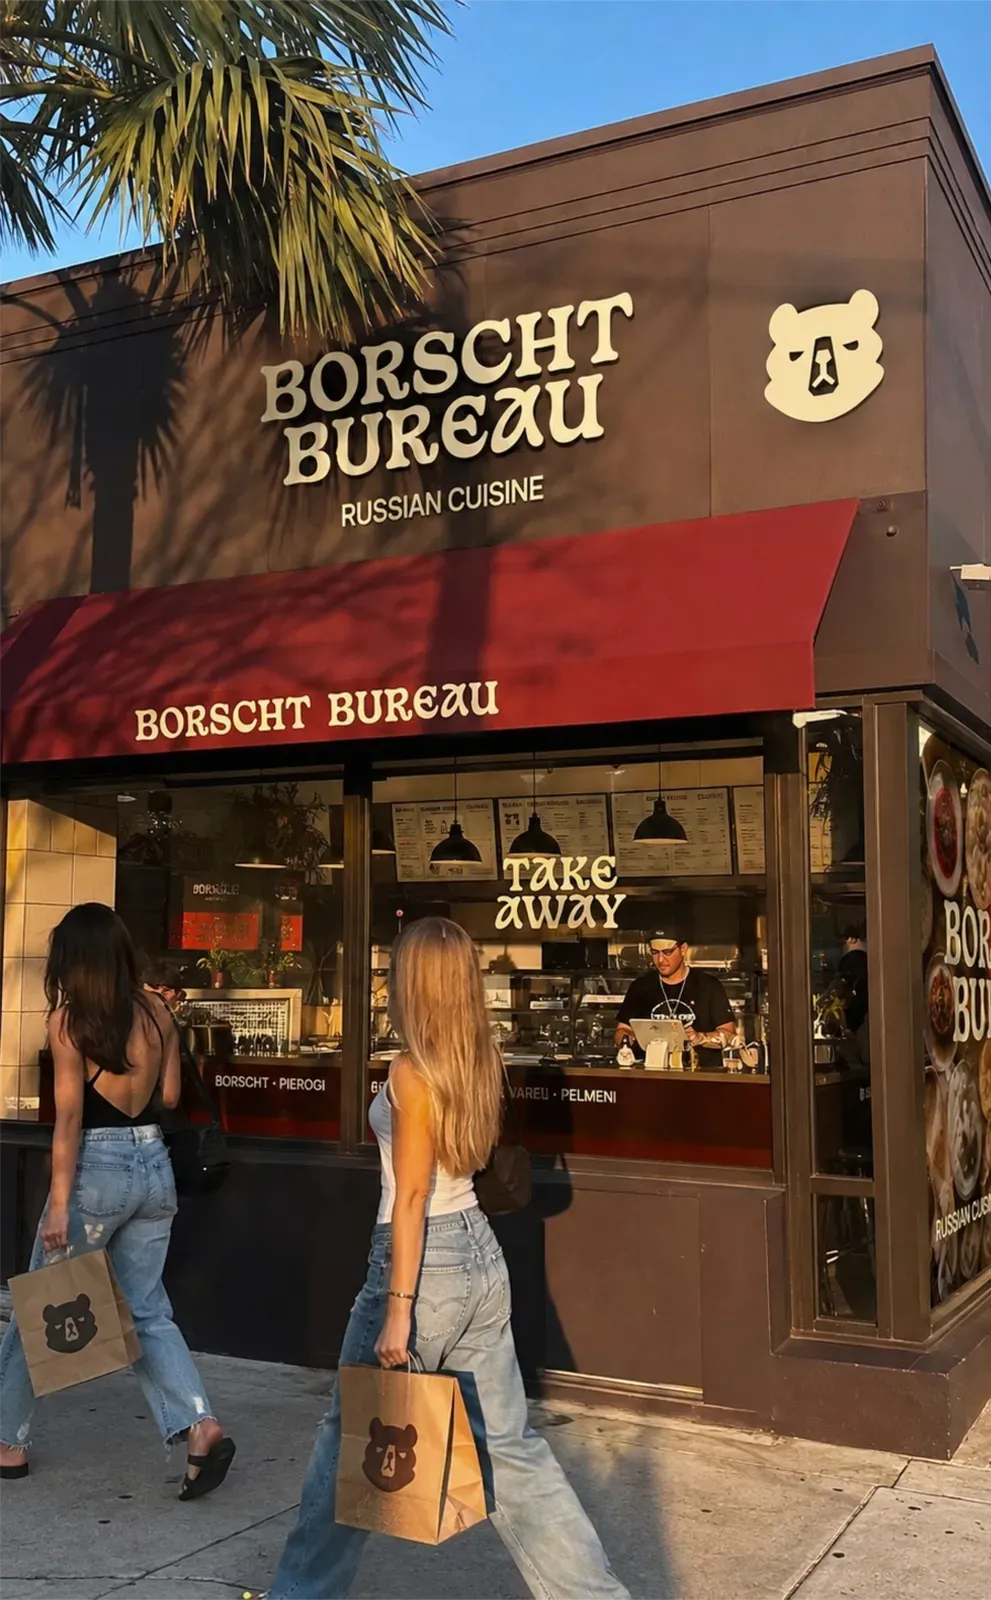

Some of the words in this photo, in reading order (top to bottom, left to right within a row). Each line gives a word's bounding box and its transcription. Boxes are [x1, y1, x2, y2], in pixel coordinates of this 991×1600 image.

[260, 292, 634, 423] BORSCHT
[283, 373, 604, 486] BUREAU
[341, 490, 442, 528] RUSSIAN
[448, 475, 544, 512] CUISINE
[135, 695, 311, 741] BORSCHT
[327, 680, 499, 726] BUREAU
[502, 855, 618, 891] TAKE
[494, 893, 627, 930] AWAY
[215, 1075, 269, 1089] BORSCHT
[279, 1077, 326, 1091] PIEROGI
[561, 1088, 617, 1104] PELMENI
[935, 1204, 971, 1242] RUSSIAN
